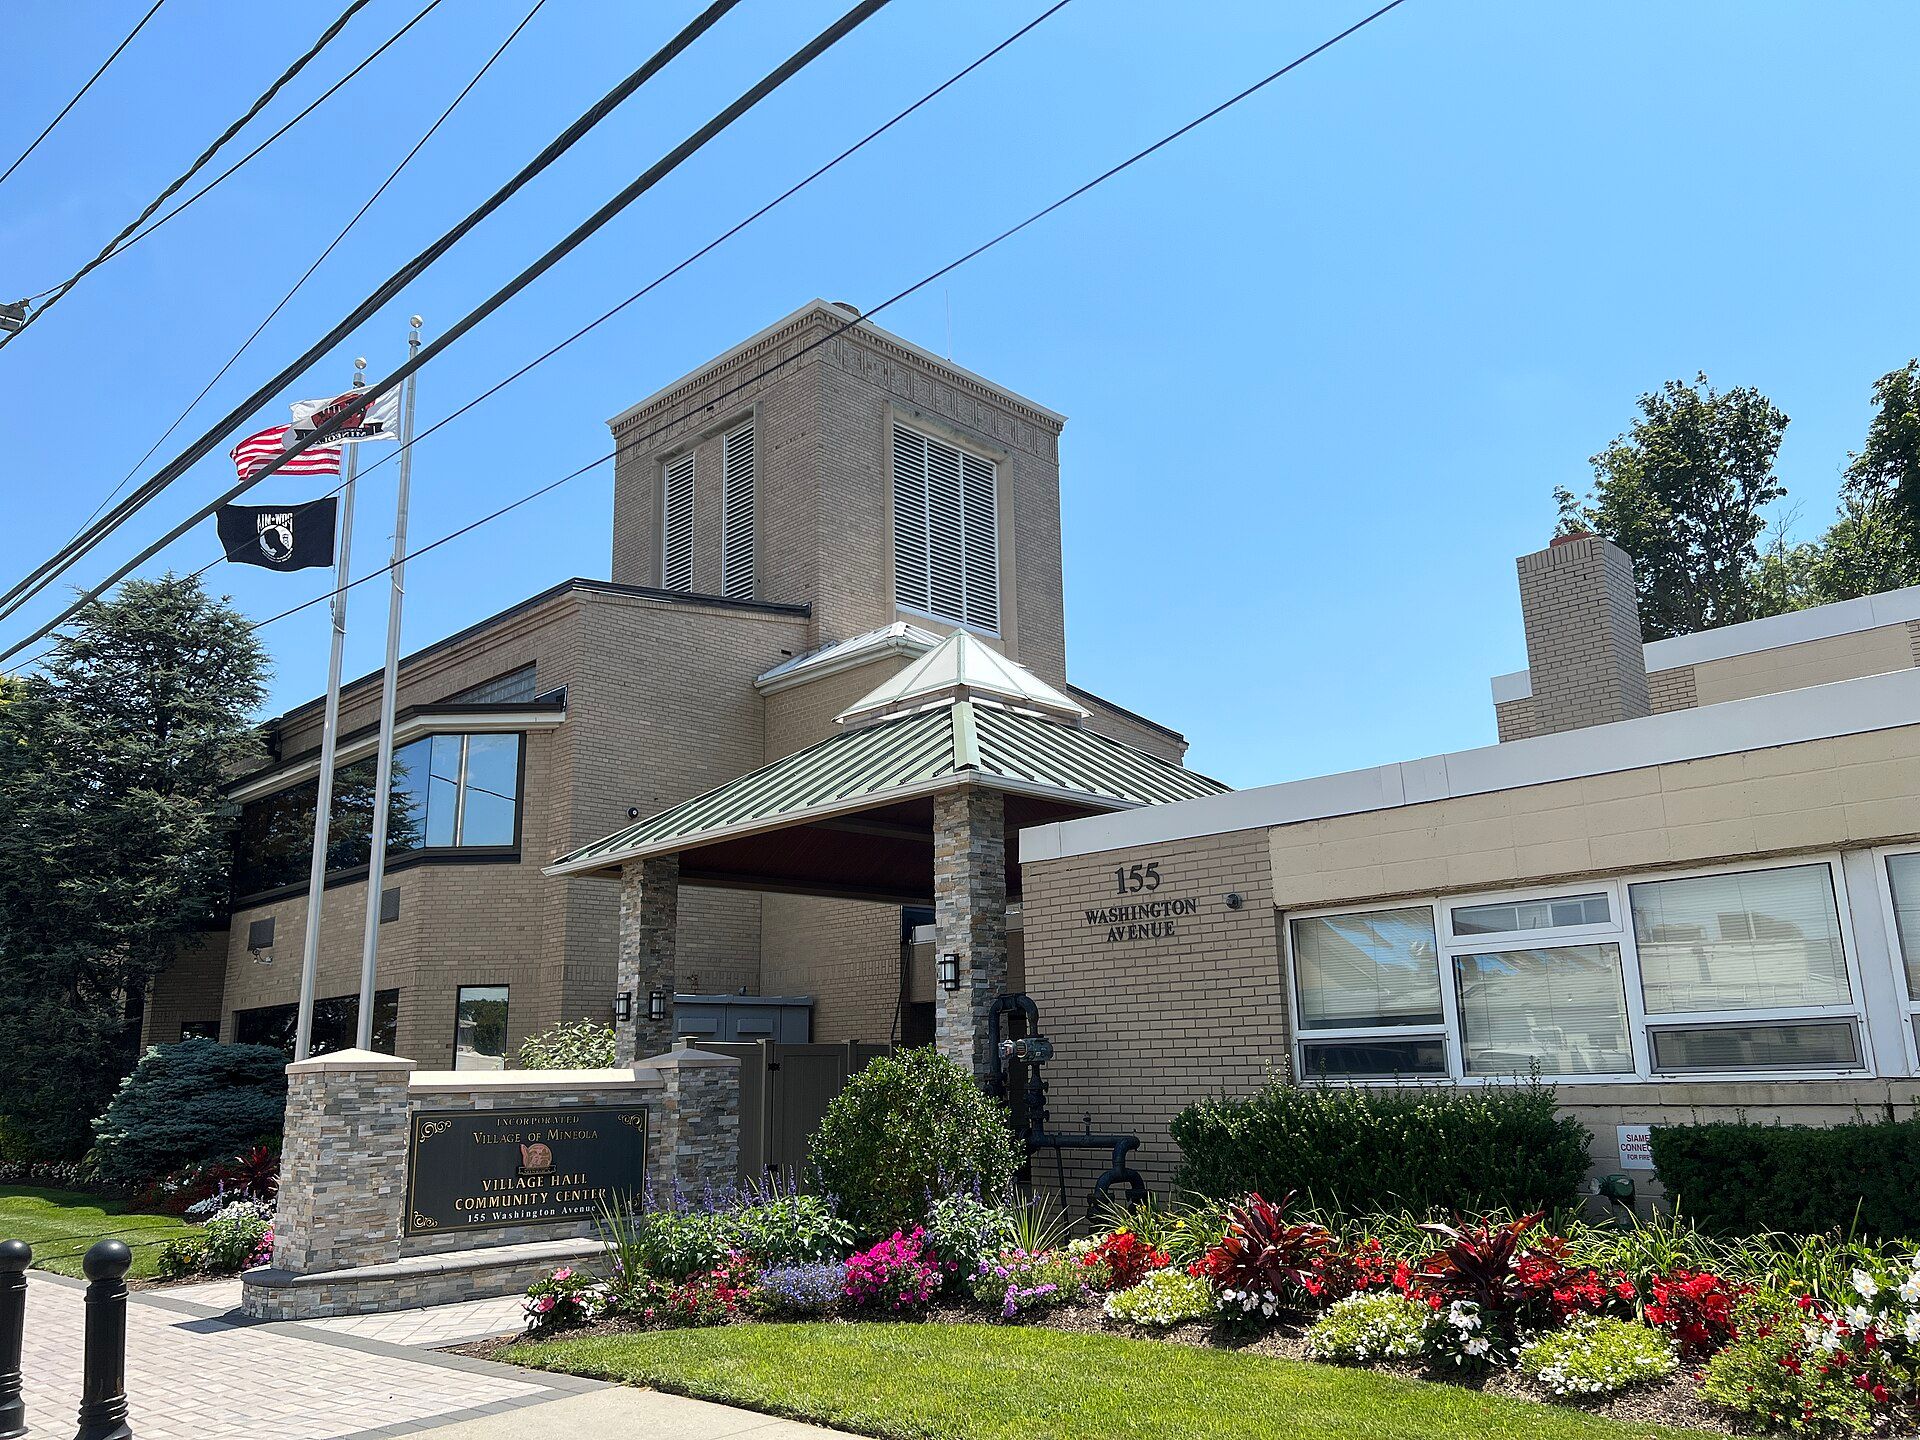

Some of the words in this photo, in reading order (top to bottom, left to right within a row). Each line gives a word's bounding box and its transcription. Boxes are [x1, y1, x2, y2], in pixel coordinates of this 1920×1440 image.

[1114, 861, 1161, 895] 155
[1085, 898, 1197, 925] WASHINGTON
[1106, 920, 1175, 942] AVENUE
[497, 1115, 580, 1127] INCORPORATED
[473, 1132, 521, 1144] VILLAGE
[546, 1128, 598, 1141] MINEOLA
[1626, 1134, 1650, 1142] SIAME
[482, 1175, 544, 1192] VILLAGE
[550, 1173, 588, 1187] HALL
[454, 1192, 549, 1211] COMMUNITY
[555, 1188, 606, 1202] CENTER
[467, 1213, 486, 1223] 155
[492, 1208, 556, 1220] Washington
[561, 1204, 596, 1215] Avenue
